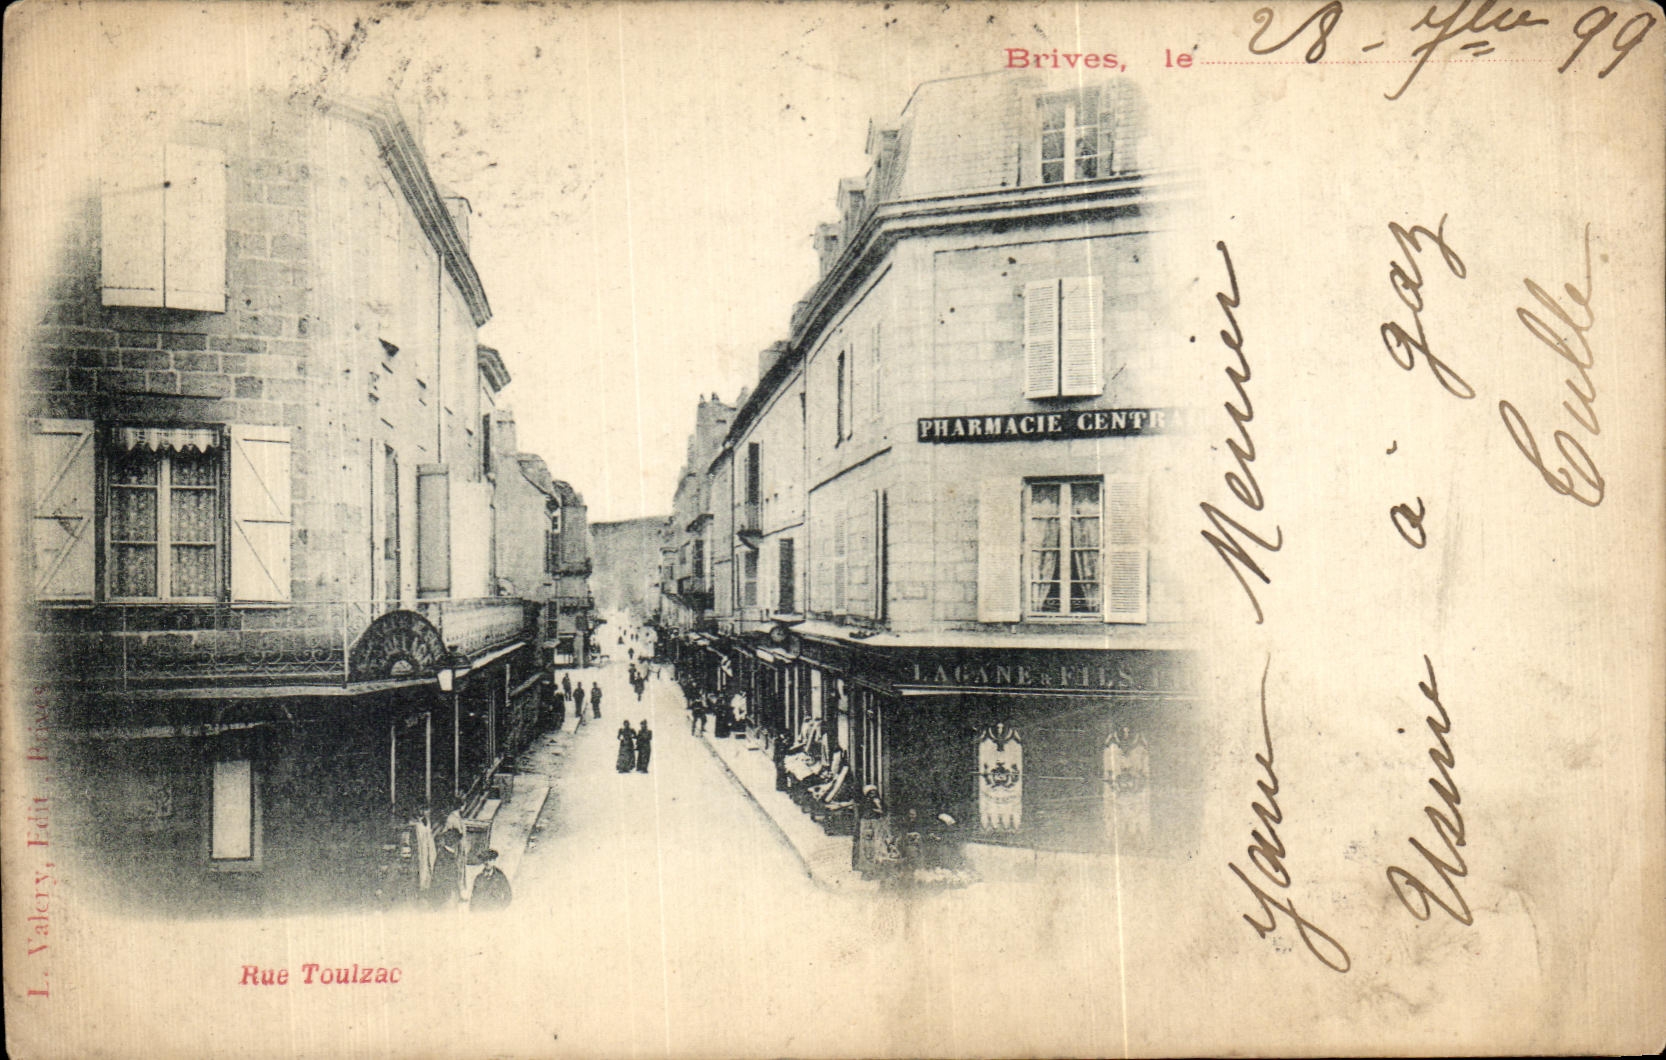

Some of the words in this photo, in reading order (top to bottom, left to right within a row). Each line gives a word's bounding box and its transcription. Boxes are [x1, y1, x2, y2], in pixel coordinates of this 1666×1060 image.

[1248, 0, 1343, 65] 28
[1556, 5, 1658, 79] 99
[1379, 211, 1476, 400] gaz
[918, 412, 1063, 439] PHARMACIE
